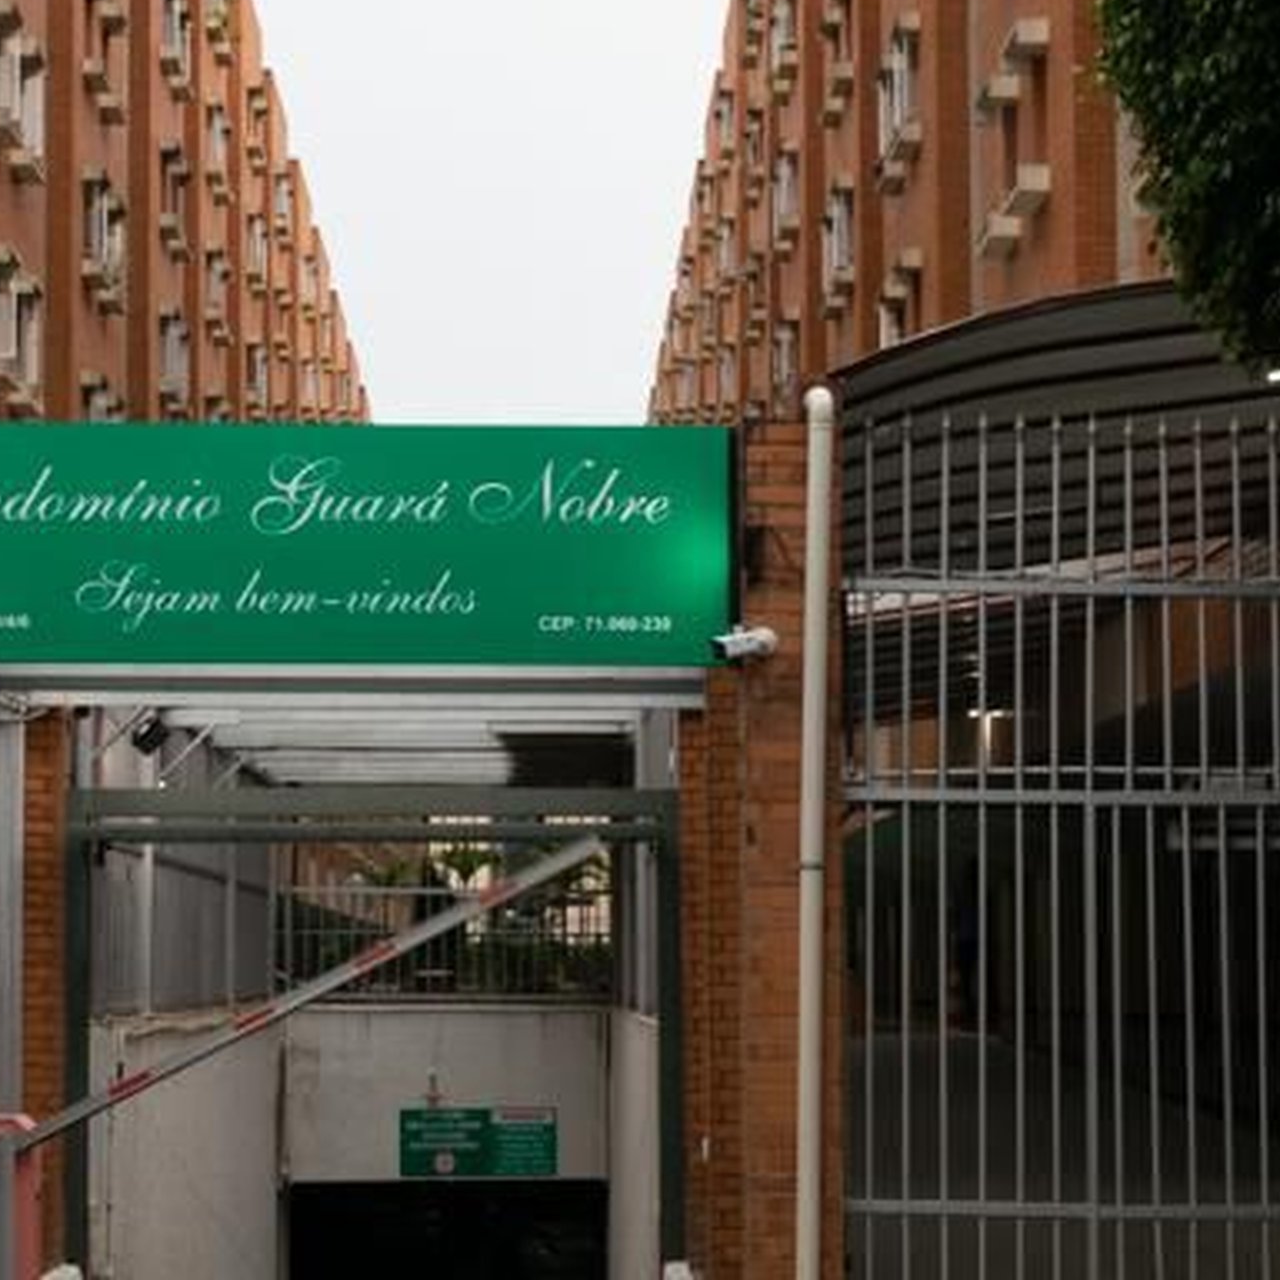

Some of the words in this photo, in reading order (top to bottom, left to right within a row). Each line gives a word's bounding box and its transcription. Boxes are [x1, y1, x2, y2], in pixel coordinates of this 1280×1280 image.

[249, 454, 450, 535] Guará
[468, 458, 671, 525] Nobre
[74, 562, 221, 632] Sejam
[234, 569, 476, 614] bem-vindos
